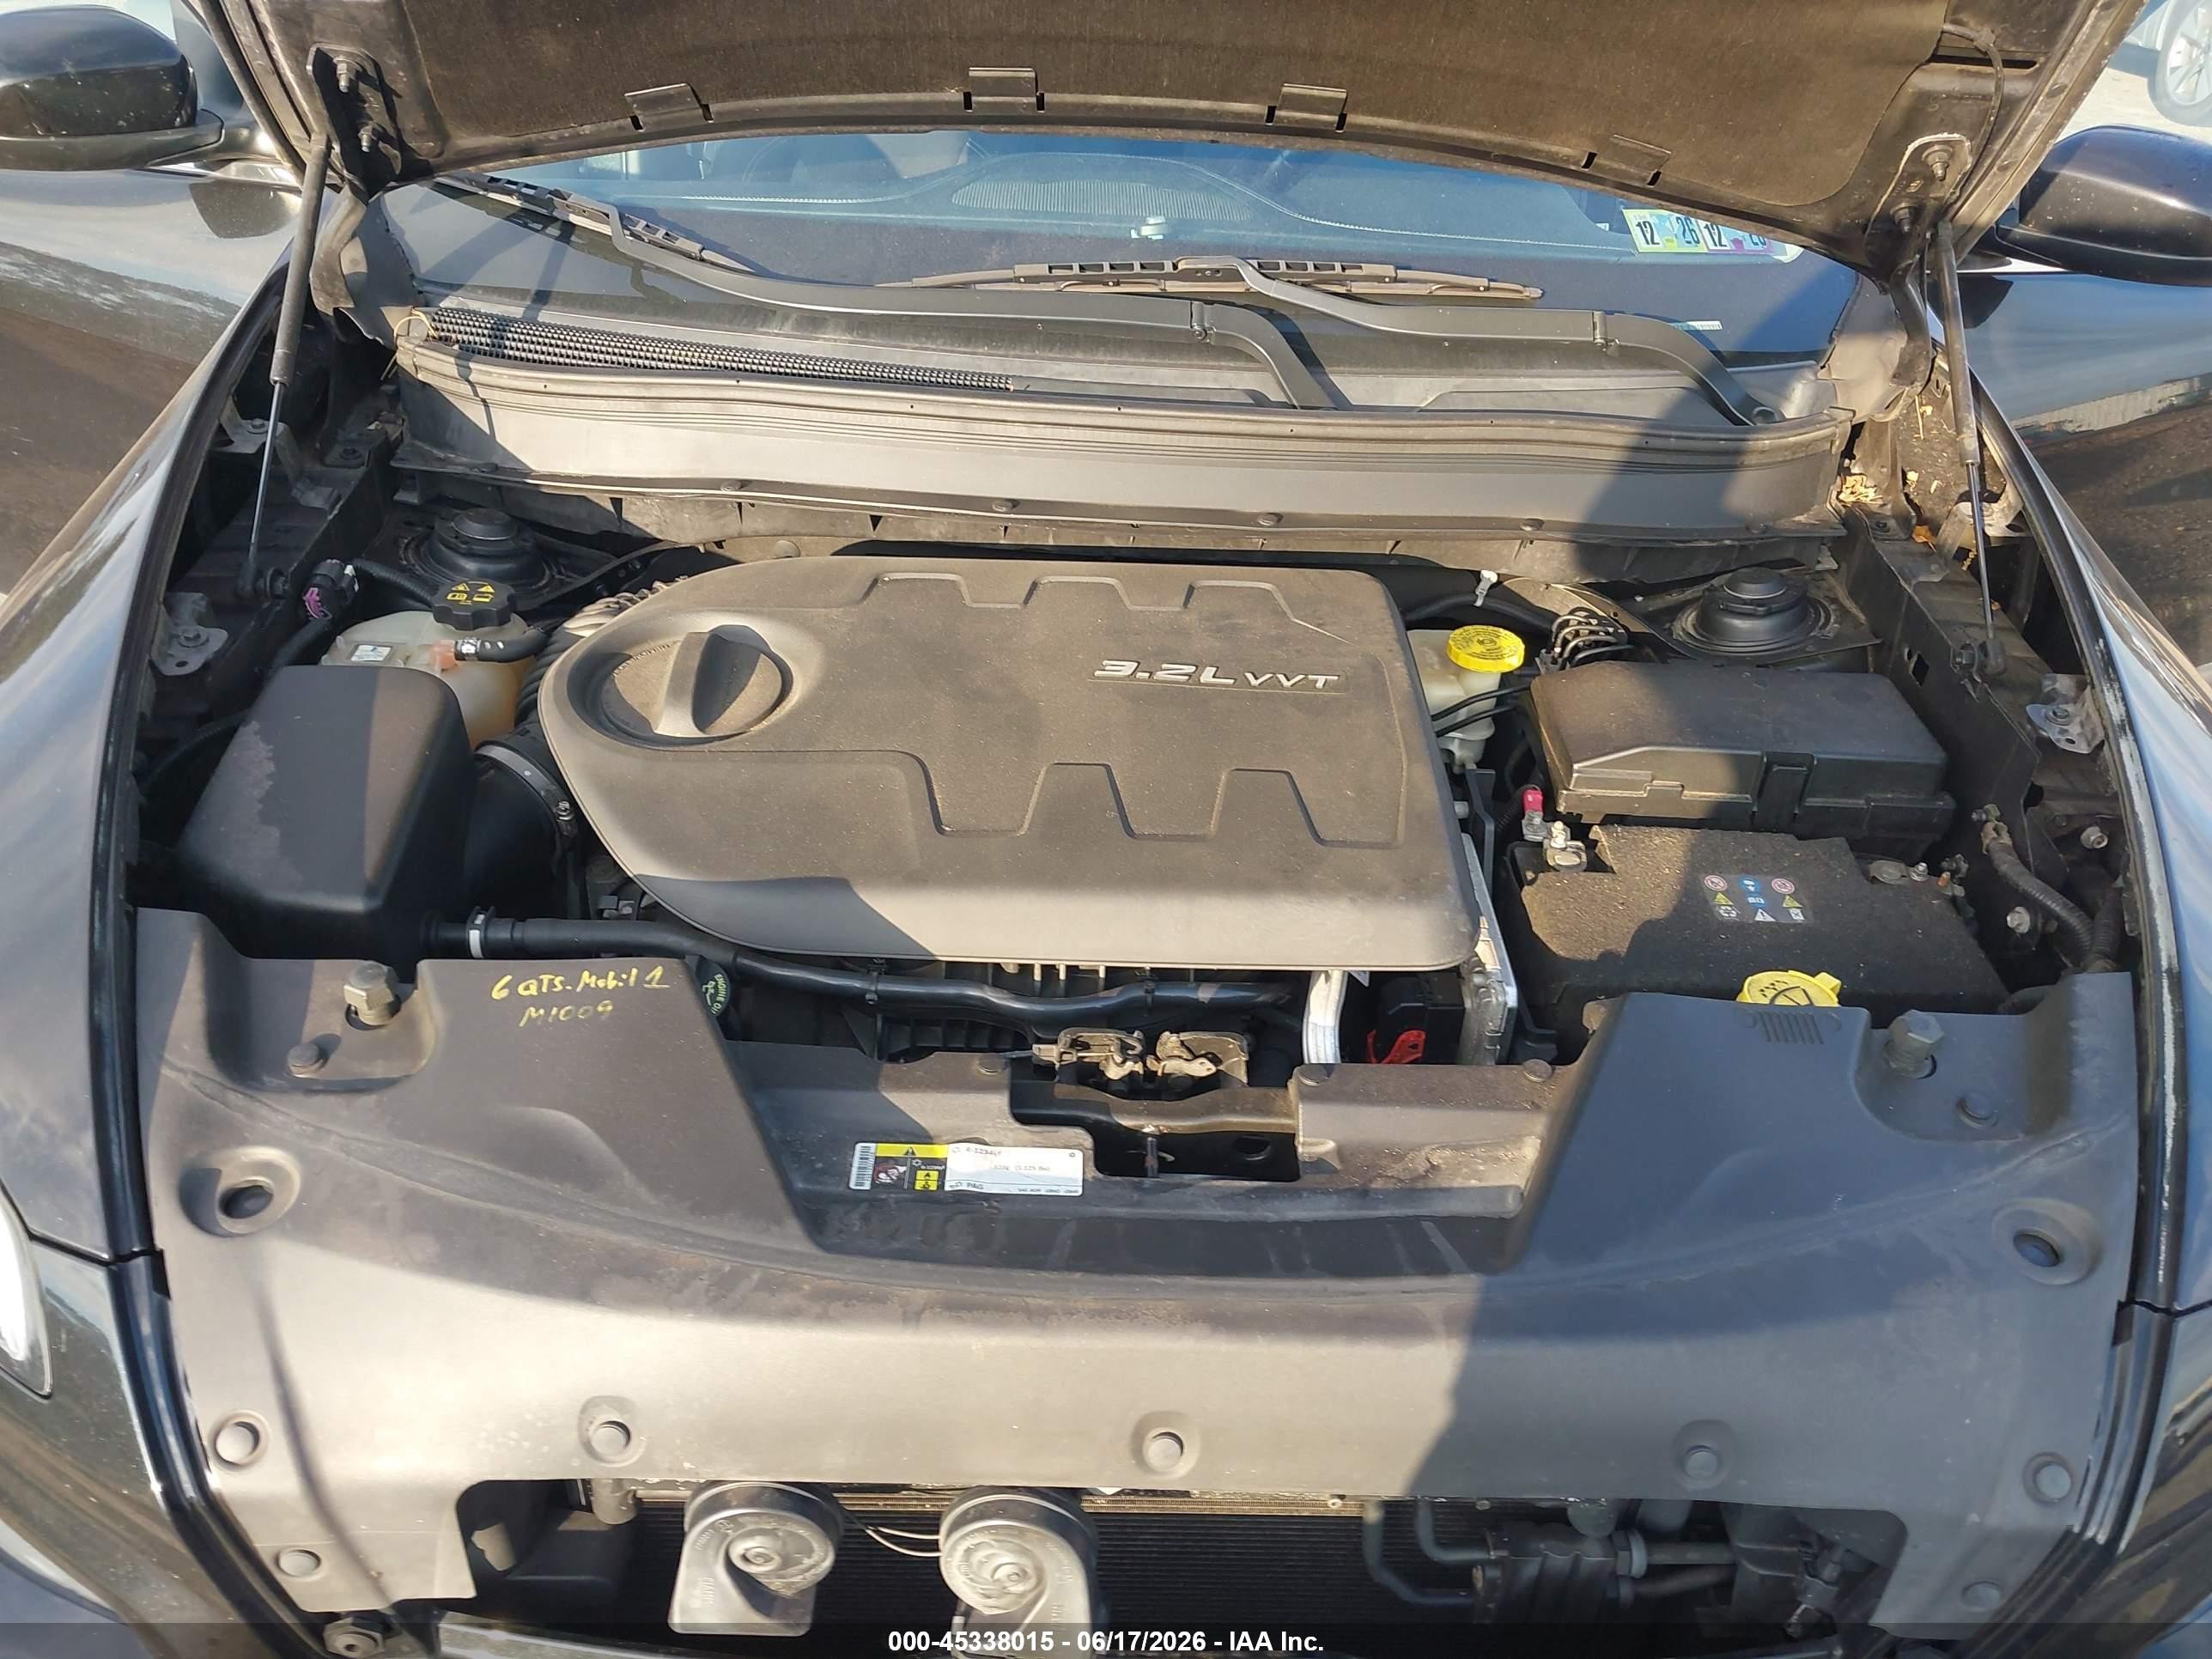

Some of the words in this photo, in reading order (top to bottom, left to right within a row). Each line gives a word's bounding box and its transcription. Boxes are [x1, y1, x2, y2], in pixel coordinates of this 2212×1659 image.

[1635, 220, 1661, 246] 12
[1676, 216, 1701, 246] 26
[1703, 223, 1728, 247] 12
[1093, 659, 1237, 685] 3.2L
[1244, 672, 1340, 689] VVT
[491, 974, 514, 1000] 6
